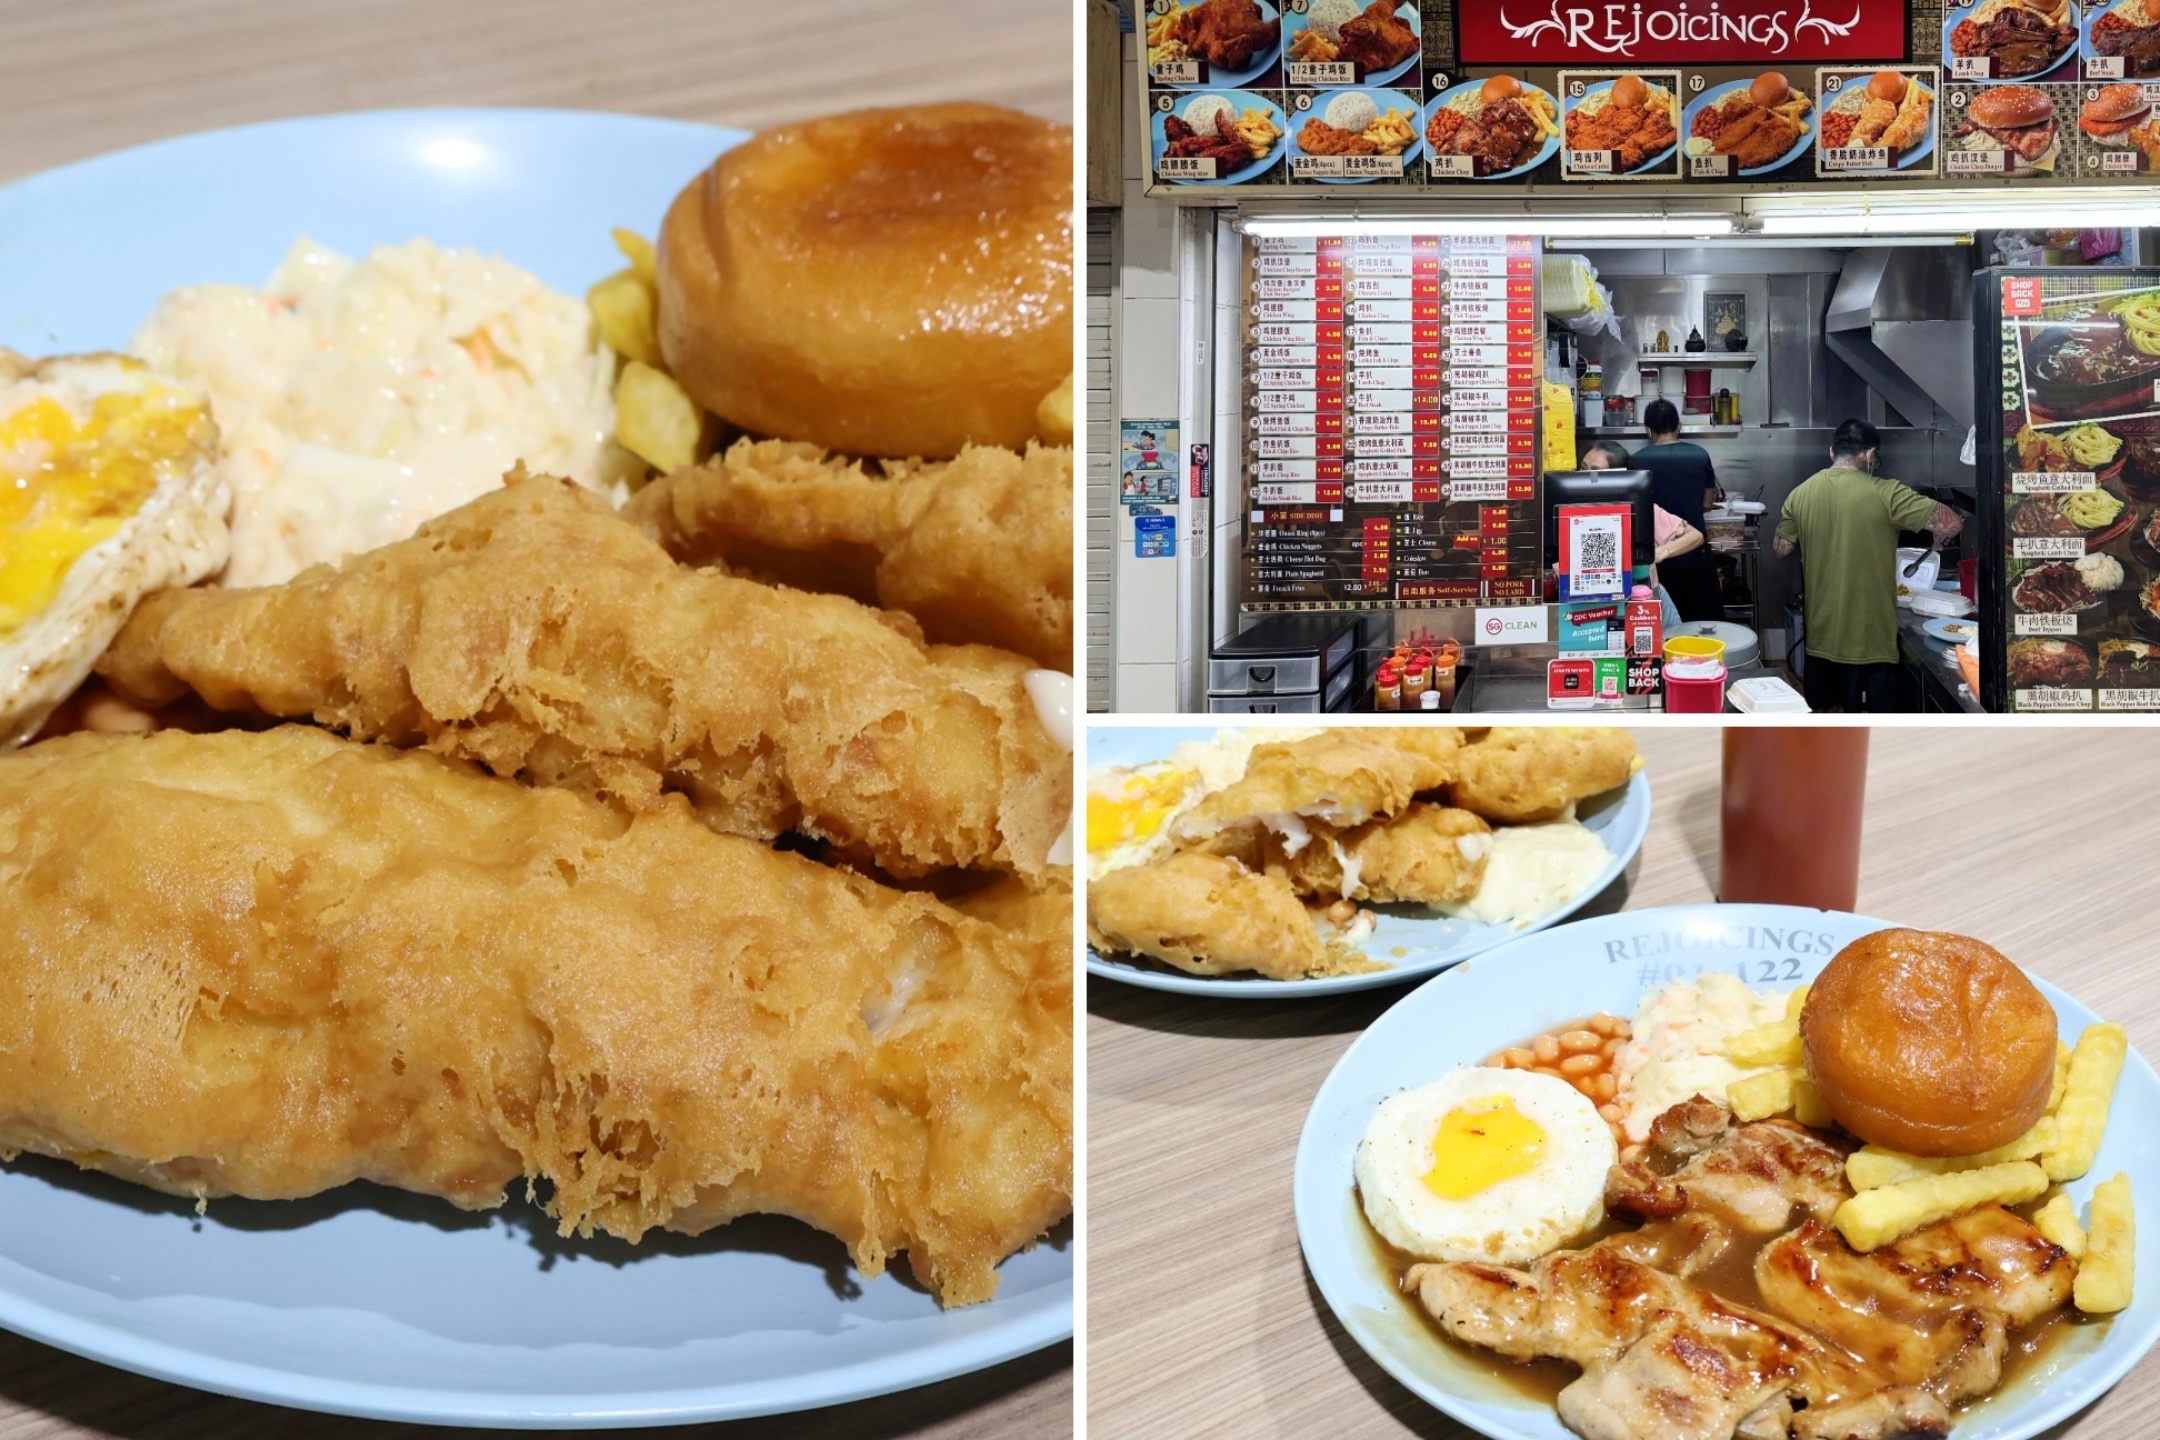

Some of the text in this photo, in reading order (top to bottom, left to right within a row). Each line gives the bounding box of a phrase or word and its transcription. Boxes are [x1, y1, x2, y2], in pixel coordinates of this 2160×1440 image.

[1956, 60, 1973, 69] 羊扒
[2091, 59, 2108, 69] 牛扒
[1435, 76, 1446, 87] 16
[1690, 78, 1703, 88] 17
[1829, 79, 1840, 88] 21
[1572, 83, 1583, 94] 15
[1163, 99, 1169, 108] 5
[1301, 99, 1307, 107] 6
[1955, 95, 1961, 103] 2
[2011, 281, 2032, 289] SHOP
[1589, 610, 1614, 618] Voucher
[1505, 621, 1537, 630] CLEAN
[2017, 616, 2072, 626] 牛肉铁板烧
[1572, 626, 1605, 636] Accepted
[1629, 668, 1659, 676] SHOP
[1629, 678, 1659, 687] BACK
